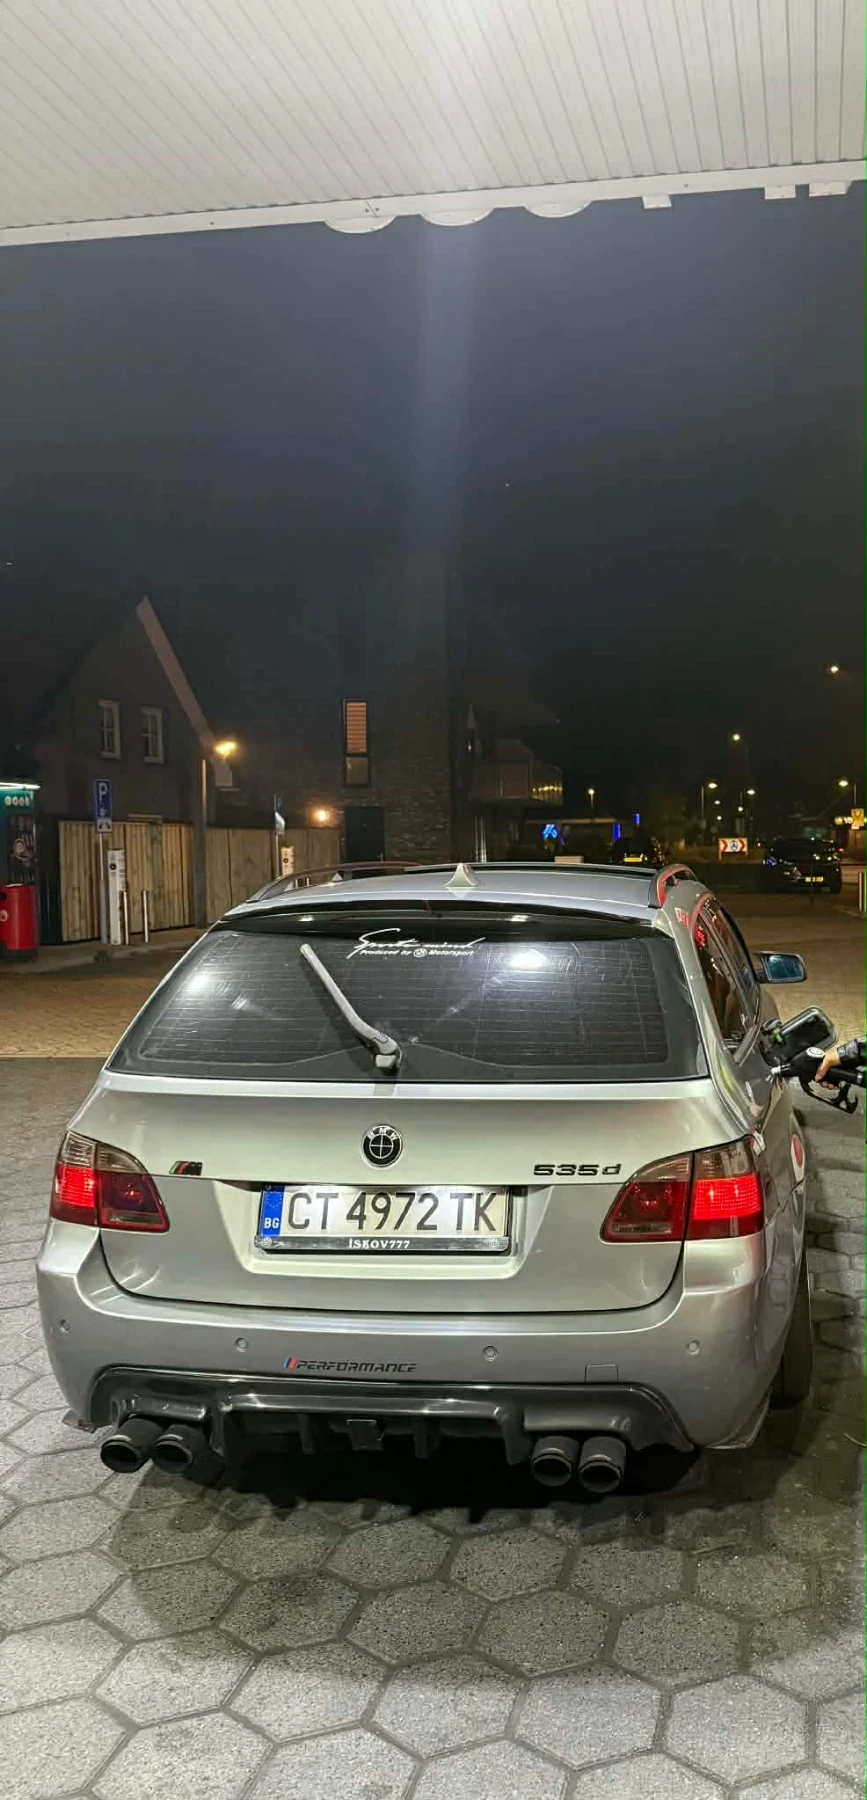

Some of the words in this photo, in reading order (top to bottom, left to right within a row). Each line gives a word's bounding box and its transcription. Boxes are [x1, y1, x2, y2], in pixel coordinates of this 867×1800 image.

[98, 782, 108, 802] P
[400, 949, 412, 957] by
[428, 949, 474, 957] Motorsport
[533, 1163, 622, 1176] 535d
[288, 1192, 339, 1230] CT
[346, 1192, 439, 1230] 4972
[450, 1192, 497, 1232] TK
[264, 1218, 280, 1229] BG
[296, 1360, 418, 1373] PERFORMANCE
